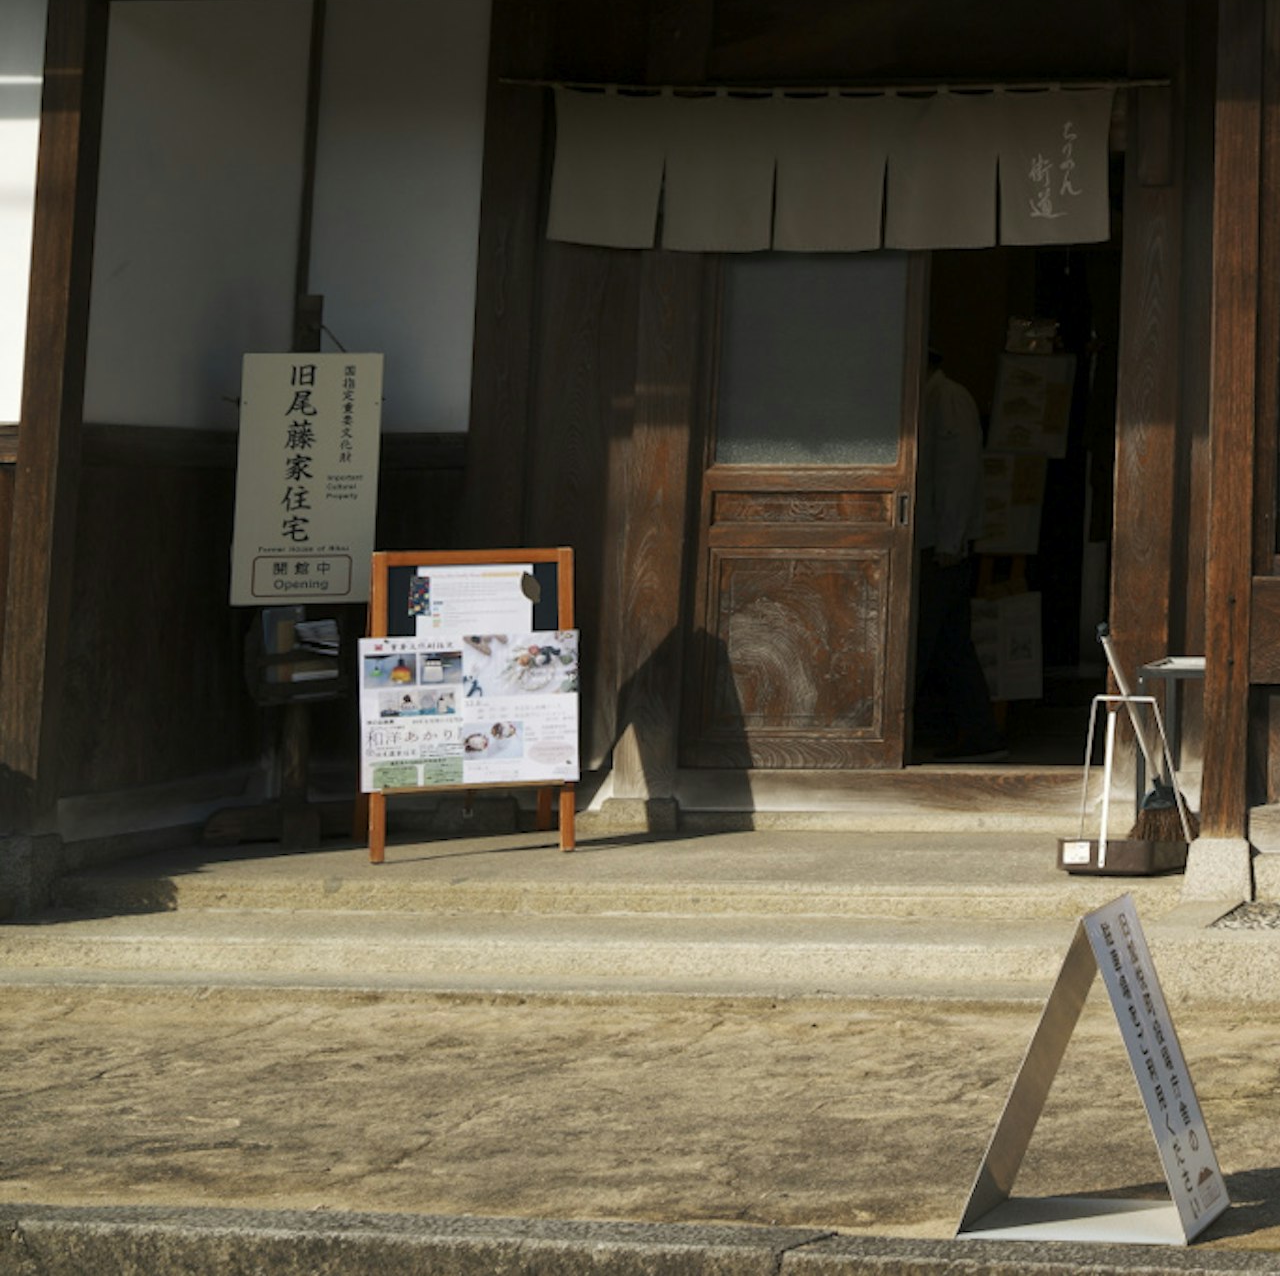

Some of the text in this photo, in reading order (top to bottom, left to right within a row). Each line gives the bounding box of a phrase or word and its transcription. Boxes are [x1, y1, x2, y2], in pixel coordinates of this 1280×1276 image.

[339, 365, 356, 463] 国指定重要文化財
[281, 364, 317, 542] 旧尾藤家住宅
[273, 562, 331, 576] 開館中
[274, 580, 329, 592] Opening
